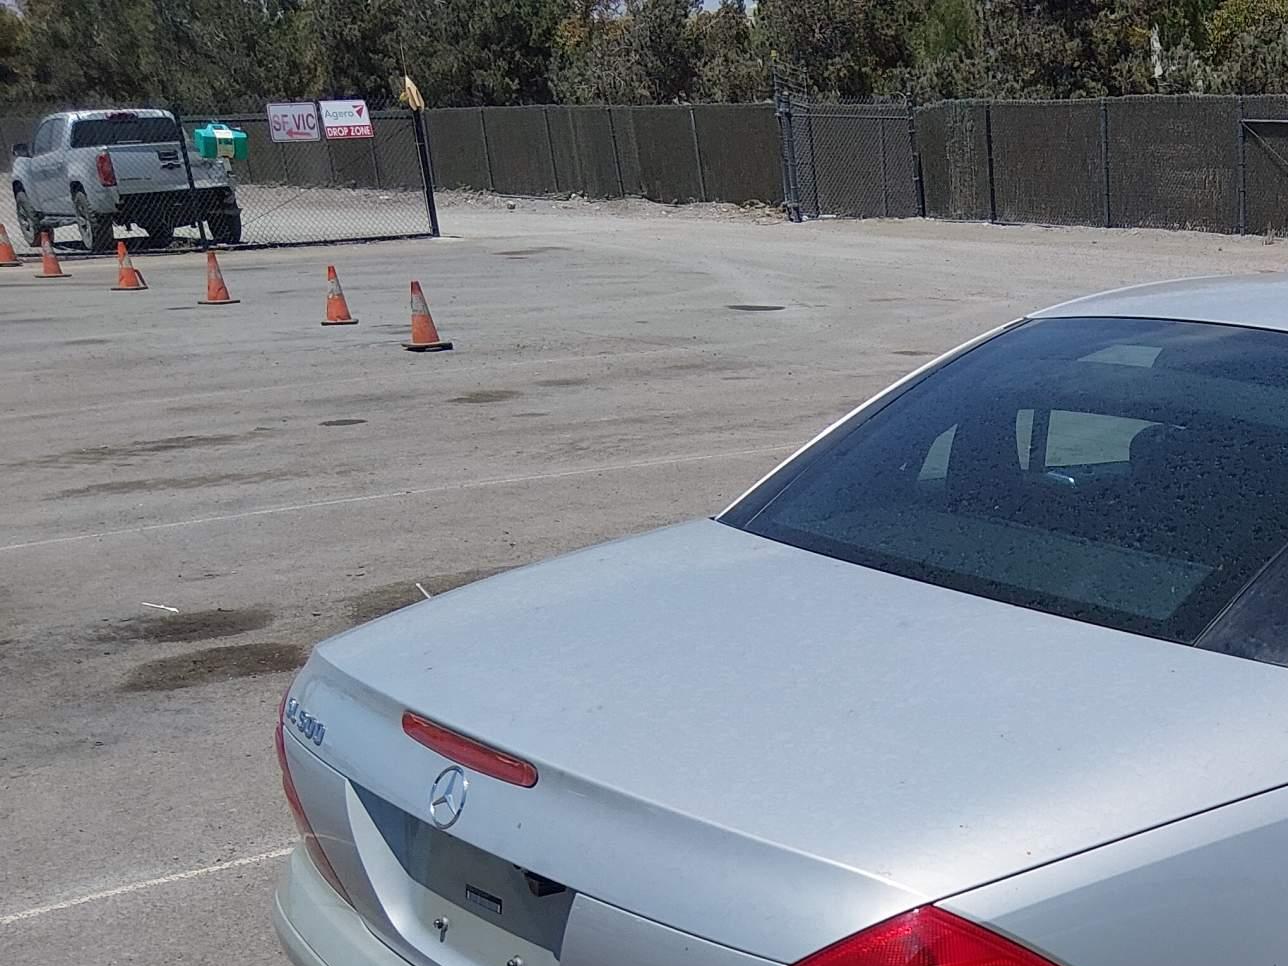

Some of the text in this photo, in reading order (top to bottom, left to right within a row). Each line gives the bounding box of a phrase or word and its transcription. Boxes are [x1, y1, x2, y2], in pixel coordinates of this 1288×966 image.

[325, 110, 354, 120] Agero
[272, 113, 316, 132] SF VIC
[327, 126, 371, 137] DROP ZONE
